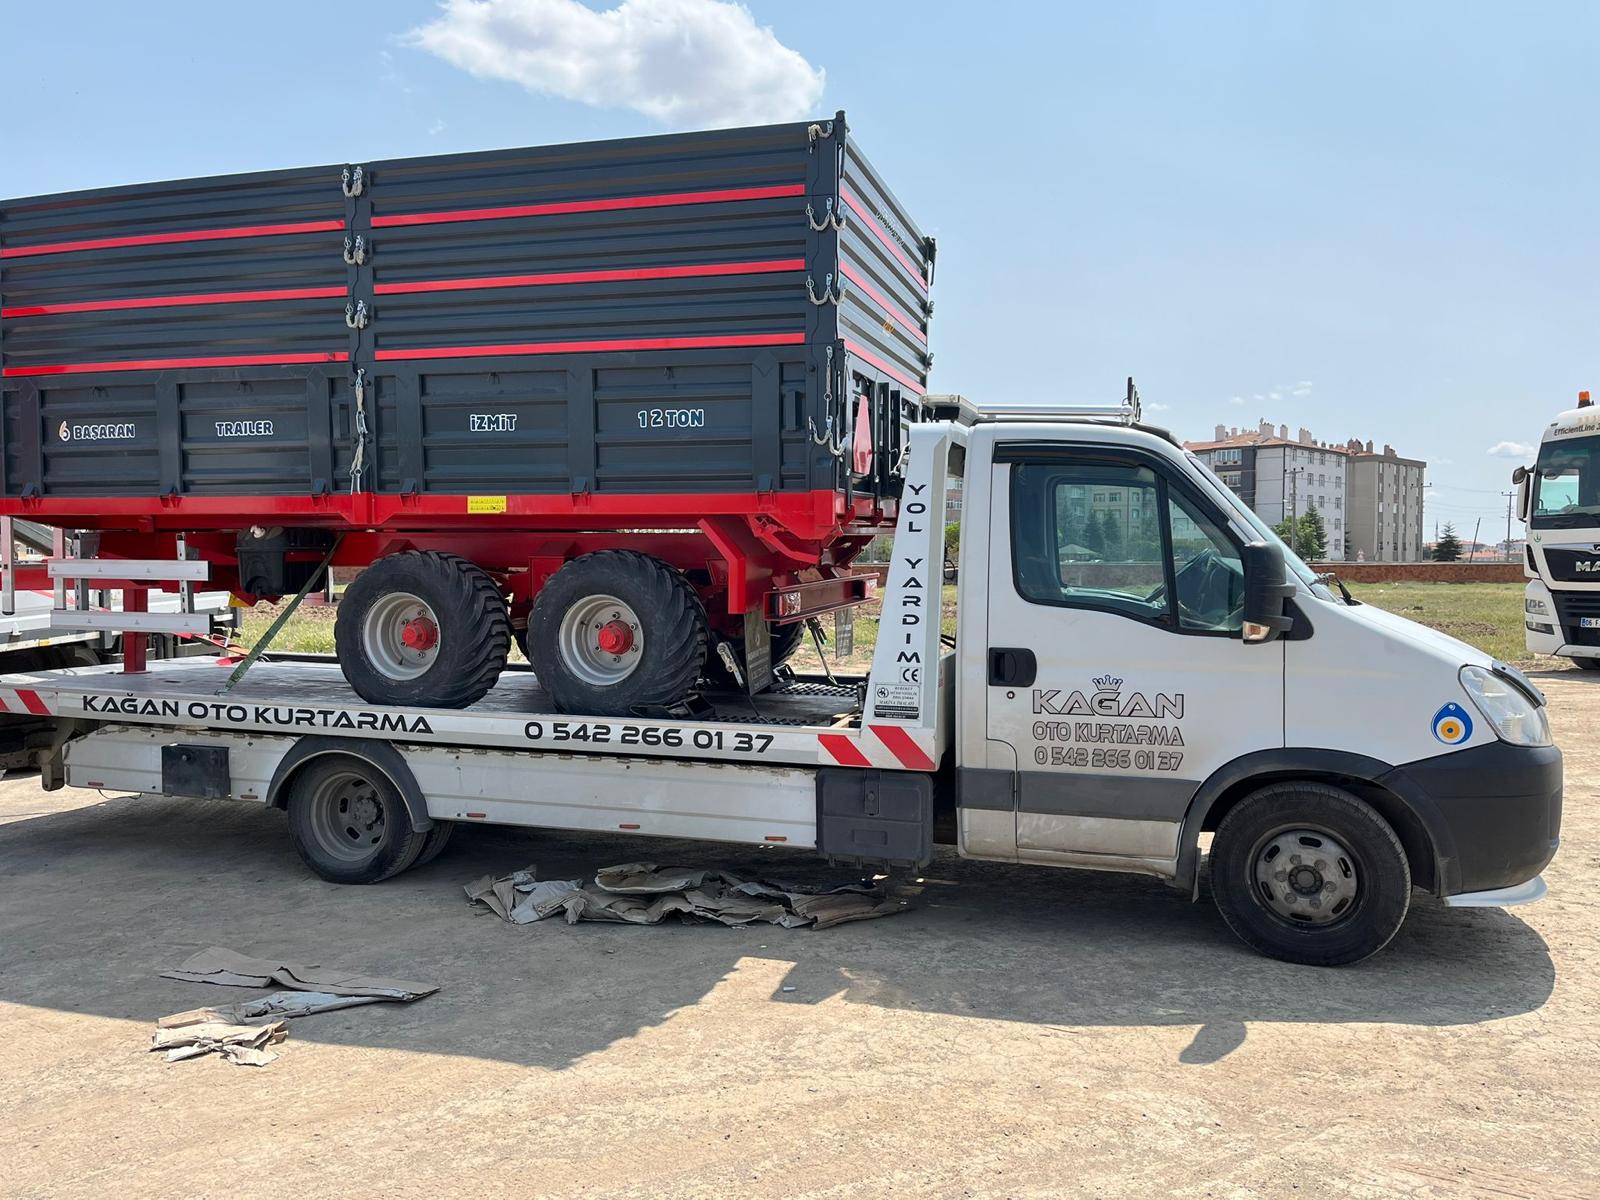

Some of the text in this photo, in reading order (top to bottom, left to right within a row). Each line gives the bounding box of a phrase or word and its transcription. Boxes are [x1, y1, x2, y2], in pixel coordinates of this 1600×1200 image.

[216, 421, 274, 437] TRAILER
[638, 409, 705, 428] 12 TON
[73, 424, 136, 440] BAŞARAN
[906, 484, 927, 533] YOL
[896, 558, 923, 663] YARDIM
[902, 668, 919, 682] CE
[82, 693, 434, 734] KAĞAN OTO KURTARMA
[524, 722, 774, 753] 0 542 266 01 37
[1032, 721, 1184, 746] OTO KURTARMA
[1034, 746, 1183, 771] 0 542 266 01 37
